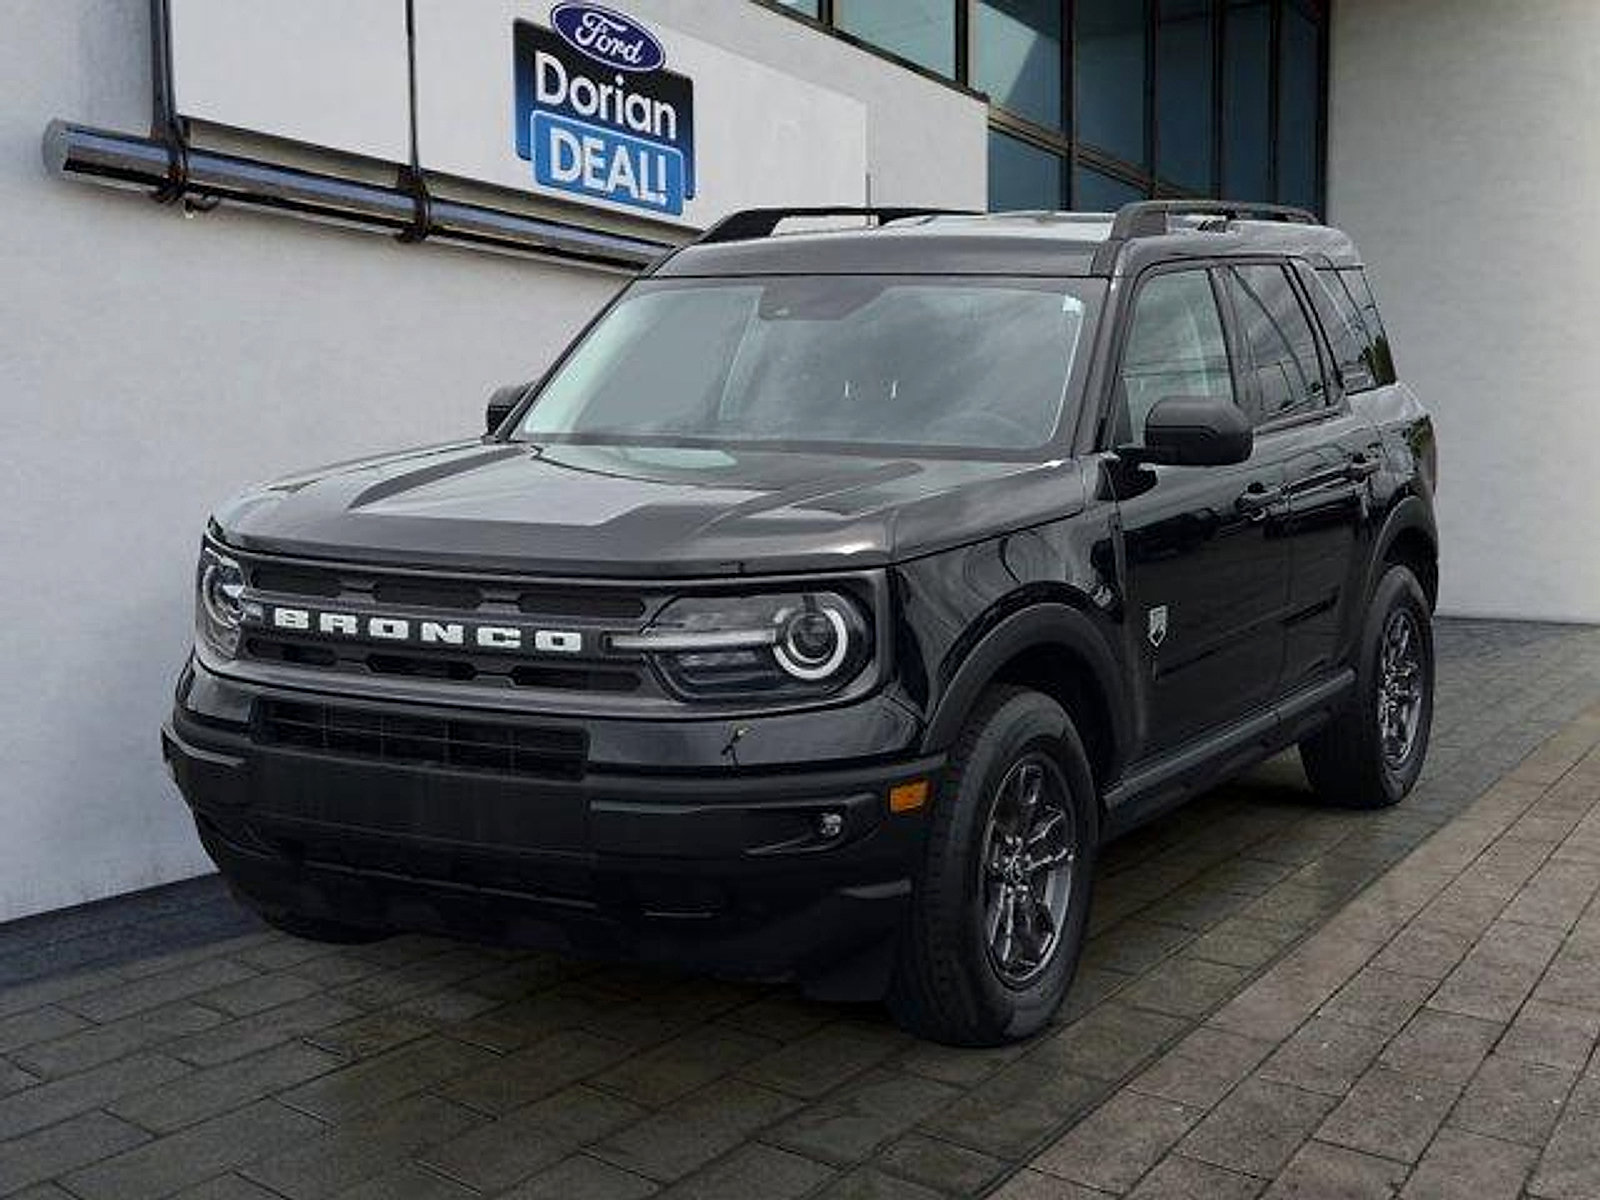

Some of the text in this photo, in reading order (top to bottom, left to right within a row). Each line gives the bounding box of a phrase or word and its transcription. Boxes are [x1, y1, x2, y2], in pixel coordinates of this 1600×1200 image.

[574, 12, 644, 64] Ford
[535, 50, 676, 140] Dorian
[550, 127, 667, 206] DEAL!
[274, 608, 582, 651] BRONCO
